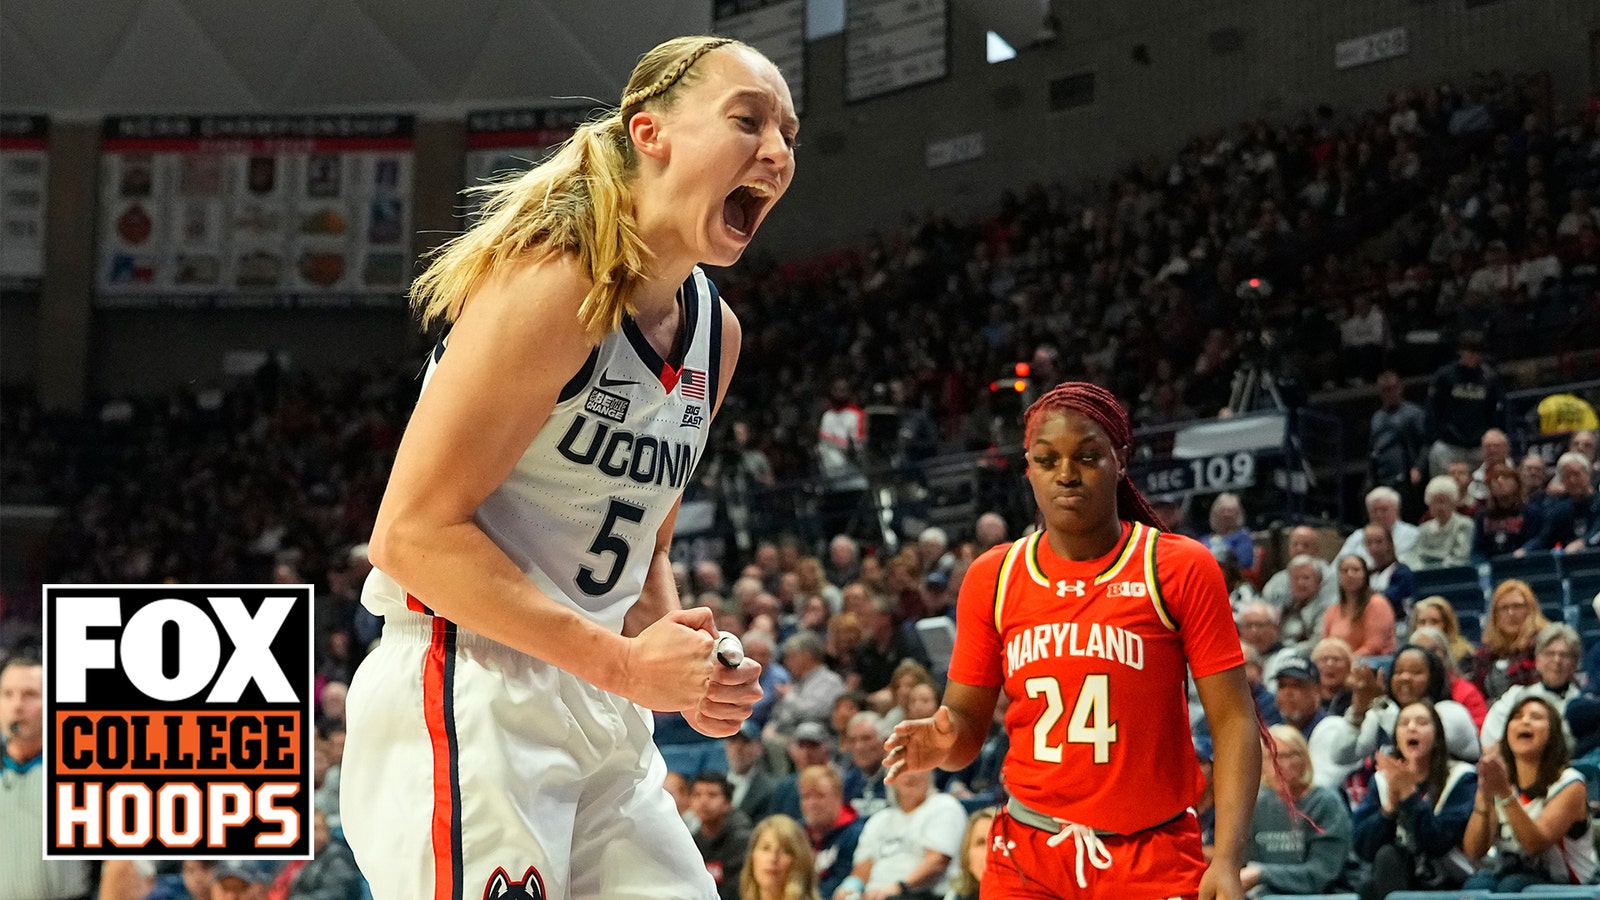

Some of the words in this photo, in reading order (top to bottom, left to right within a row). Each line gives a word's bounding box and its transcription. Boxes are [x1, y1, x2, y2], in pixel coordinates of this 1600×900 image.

[586, 401, 625, 420] CHANGE
[682, 415, 704, 426] EAST
[684, 404, 701, 415] BIG
[1146, 467, 1185, 491] SEC
[1190, 452, 1254, 491] 109
[574, 496, 647, 598] 5
[1007, 622, 1144, 678] MARYLAND
[1025, 673, 1118, 765] 24
